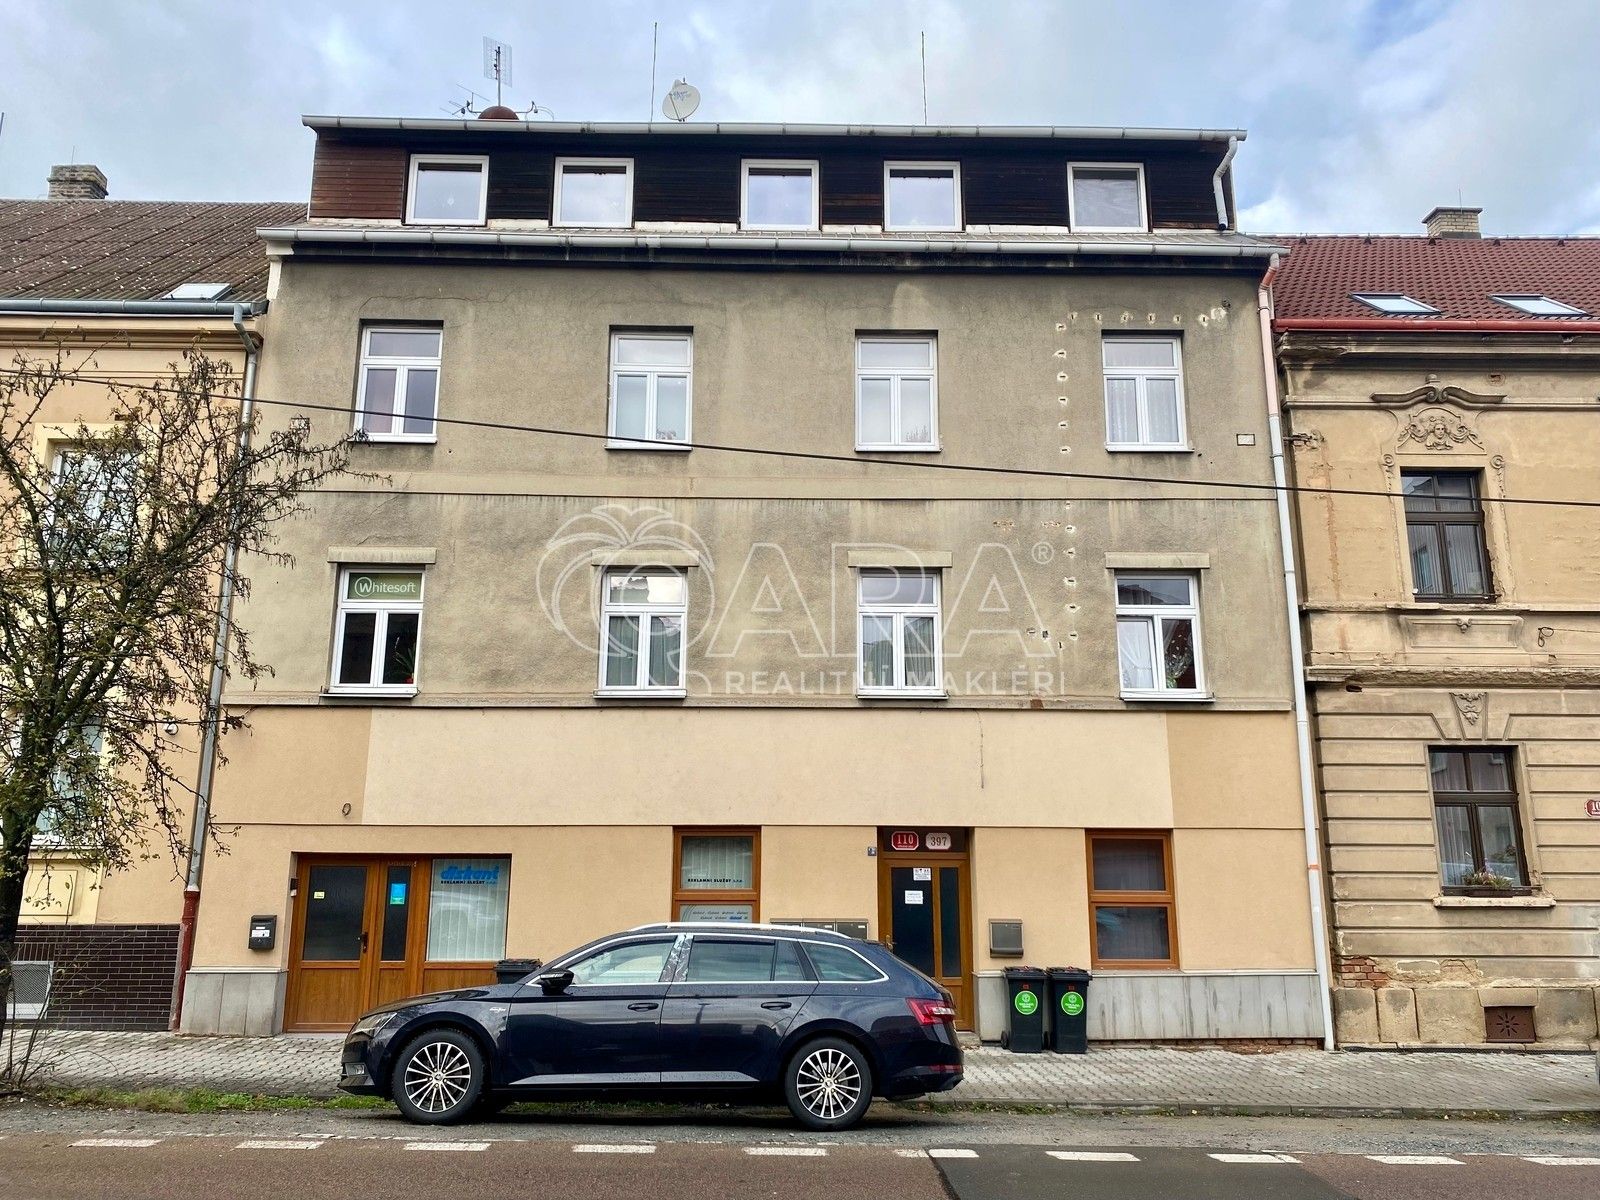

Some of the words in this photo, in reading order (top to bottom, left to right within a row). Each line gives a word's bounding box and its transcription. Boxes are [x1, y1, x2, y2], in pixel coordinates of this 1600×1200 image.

[356, 580, 416, 595] Whitesoft
[897, 834, 915, 845] 110
[930, 837, 948, 847] 397
